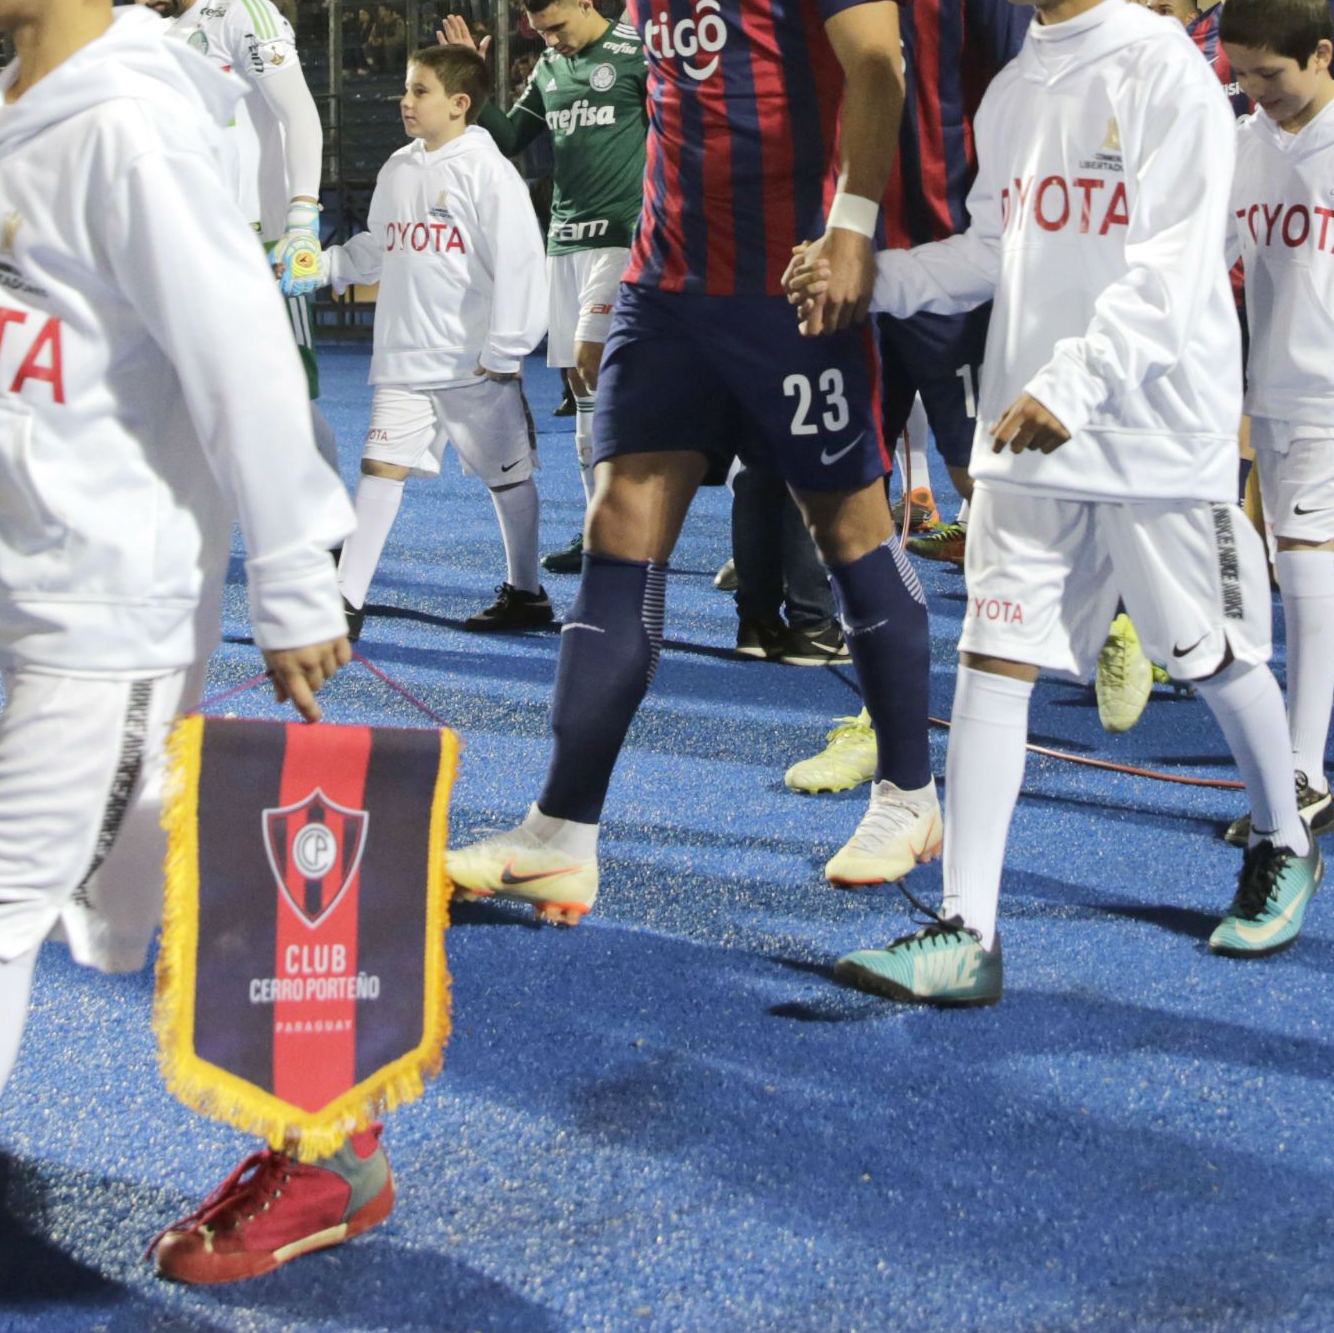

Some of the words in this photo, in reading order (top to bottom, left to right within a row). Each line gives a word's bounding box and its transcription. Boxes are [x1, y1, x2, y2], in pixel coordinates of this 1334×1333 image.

[783, 368, 851, 436] 23
[286, 943, 347, 975] CLUB
[250, 978, 303, 1003] CERRO
[305, 971, 381, 1000] PORTEÑO
[275, 1019, 353, 1033] PARAGUAY
